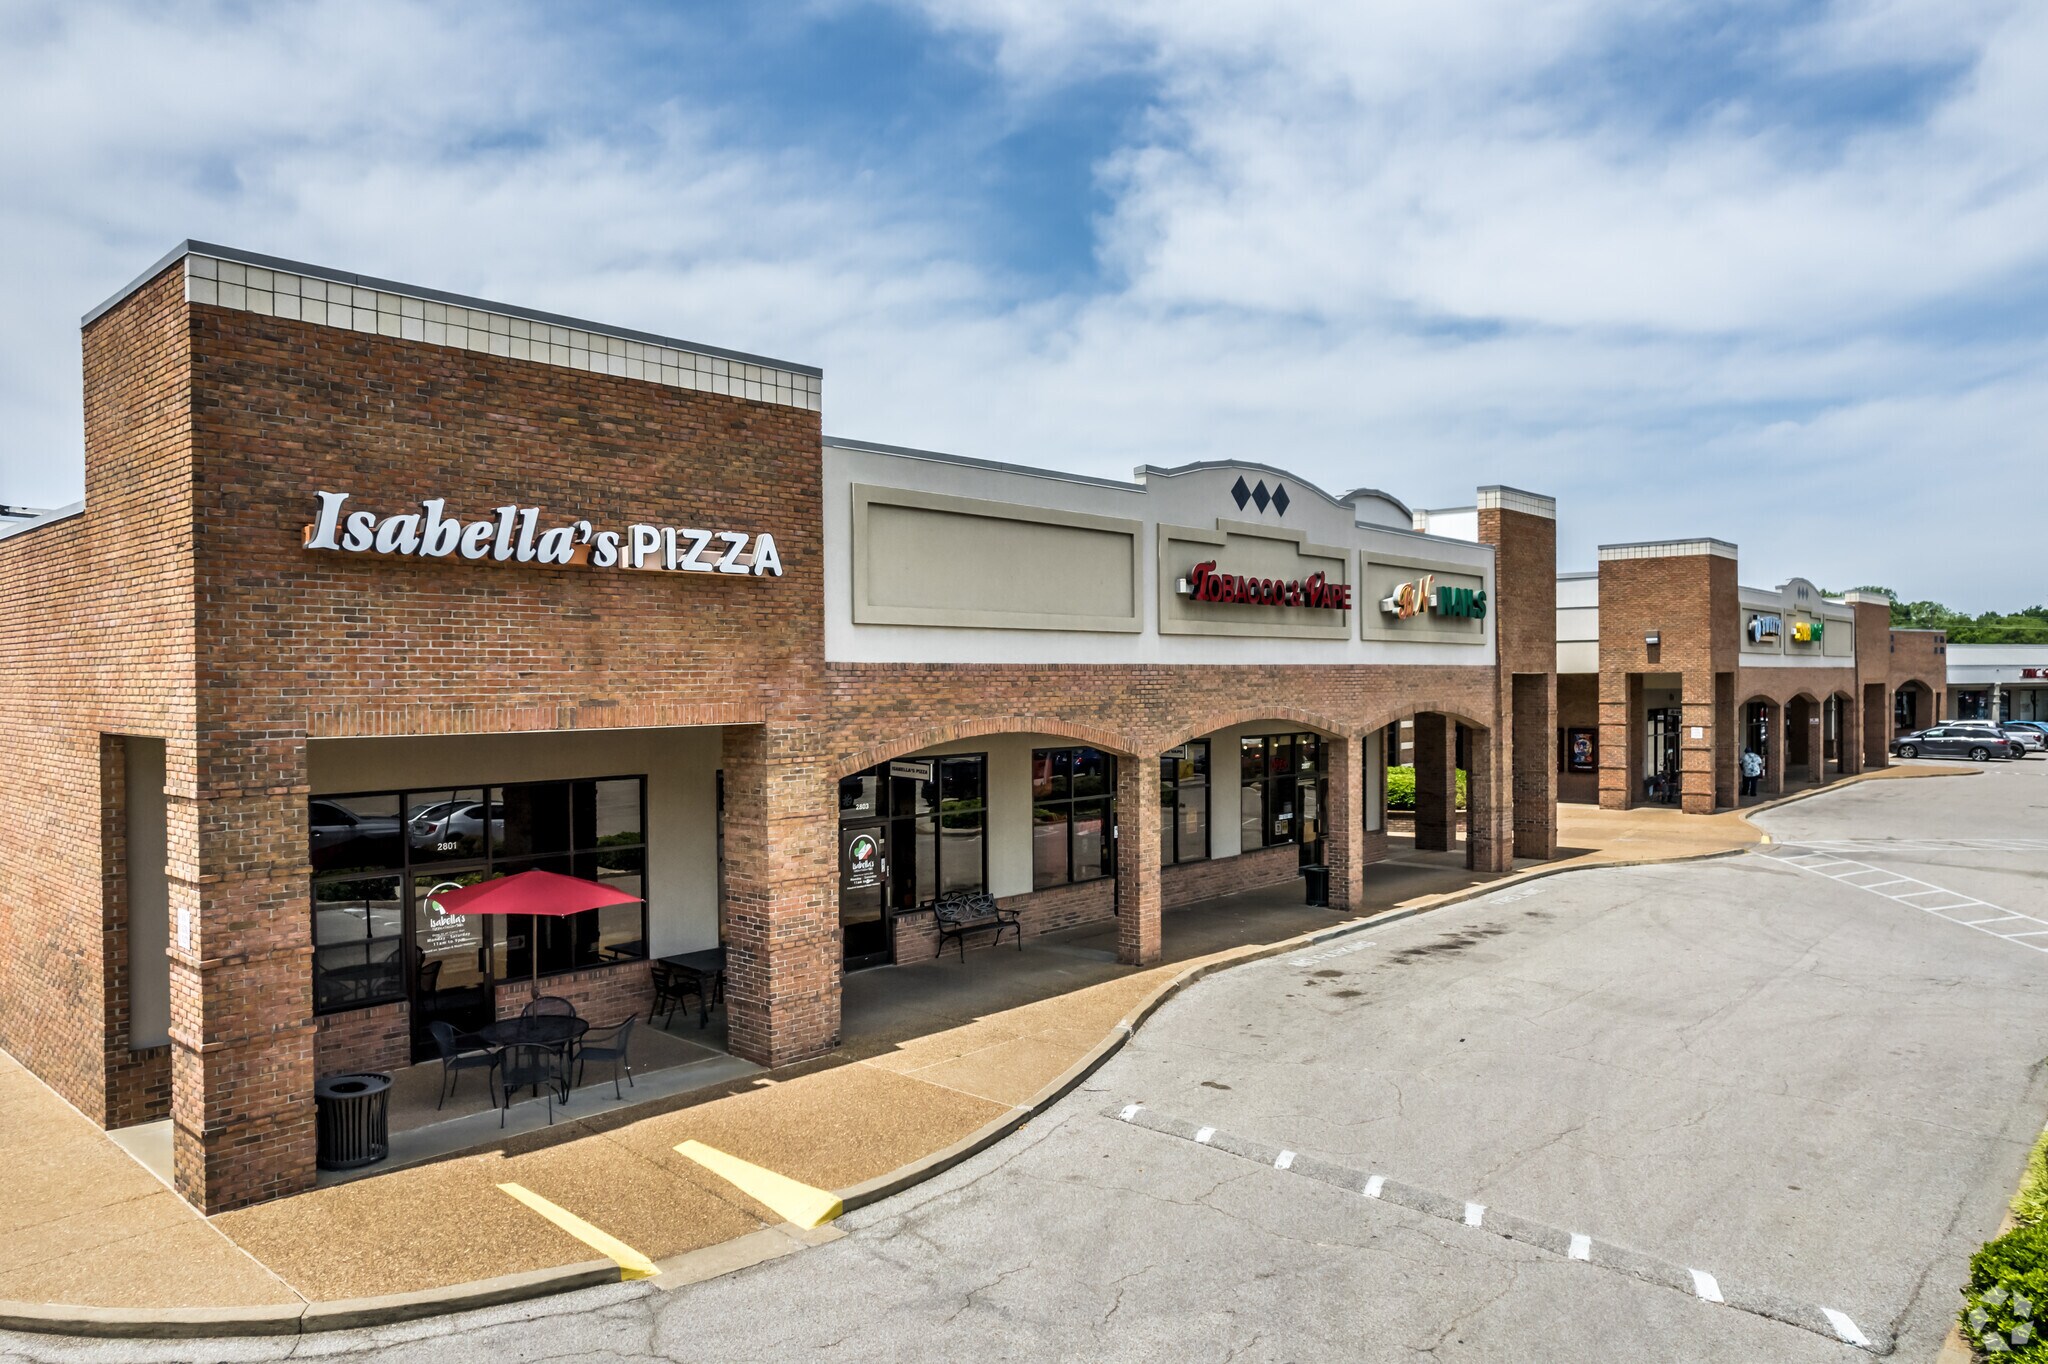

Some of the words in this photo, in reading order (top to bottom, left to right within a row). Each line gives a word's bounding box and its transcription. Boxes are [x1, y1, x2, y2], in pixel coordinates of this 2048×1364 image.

[307, 490, 620, 567] Isabella's
[627, 522, 783, 577] PIZZA
[1190, 559, 1286, 606] TOBACCO
[1304, 571, 1351, 609] VAPE
[437, 842, 457, 851] 2801
[430, 914, 465, 927] Isabella's
